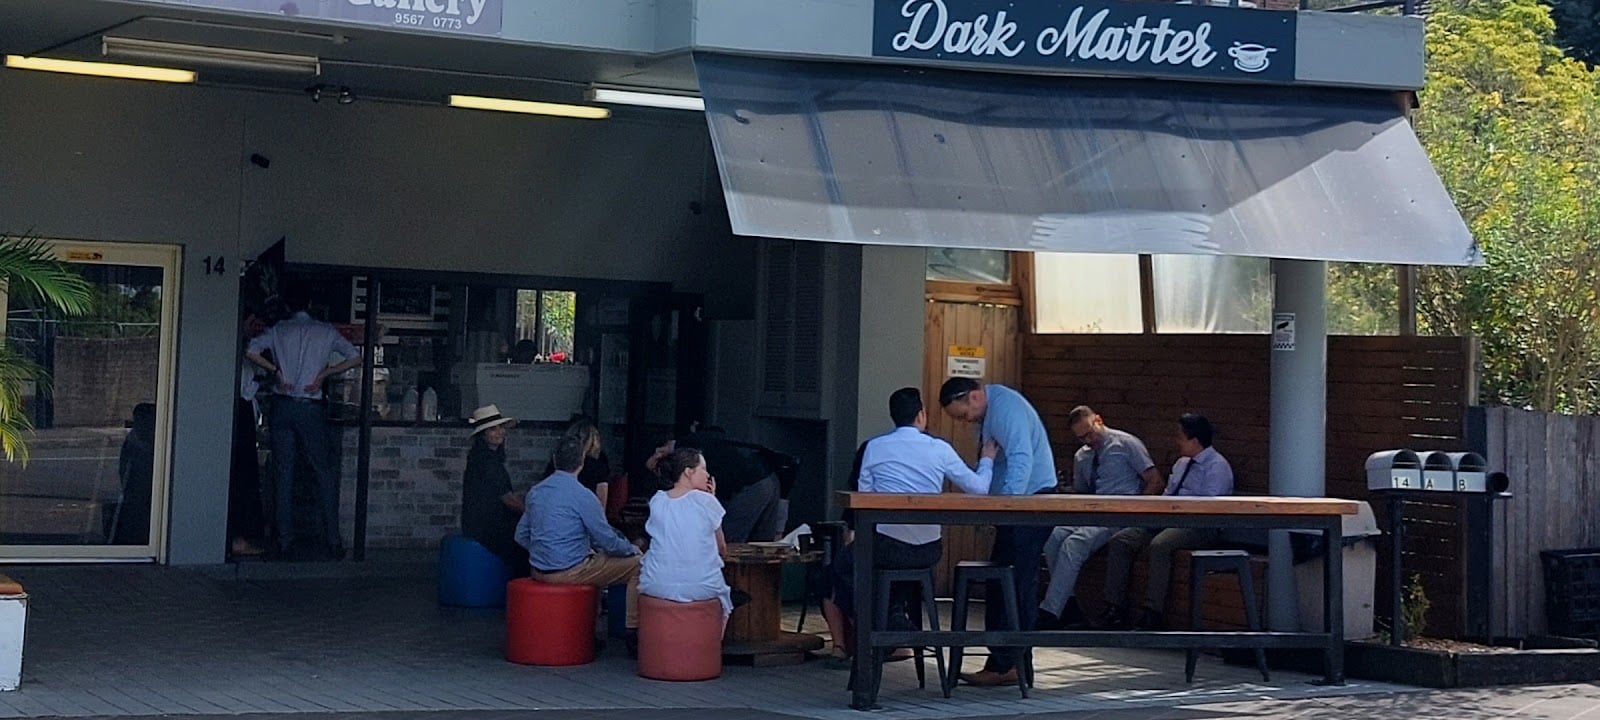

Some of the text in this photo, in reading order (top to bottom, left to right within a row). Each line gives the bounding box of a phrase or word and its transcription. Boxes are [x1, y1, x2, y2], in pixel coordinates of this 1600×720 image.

[395, 12, 425, 25] 9567
[433, 16, 462, 29] 0773
[892, 0, 1217, 67] Dark Matter
[203, 255, 225, 275] 14
[1394, 477, 1409, 488] 14
[1426, 479, 1434, 489] A
[1459, 479, 1466, 490] B
